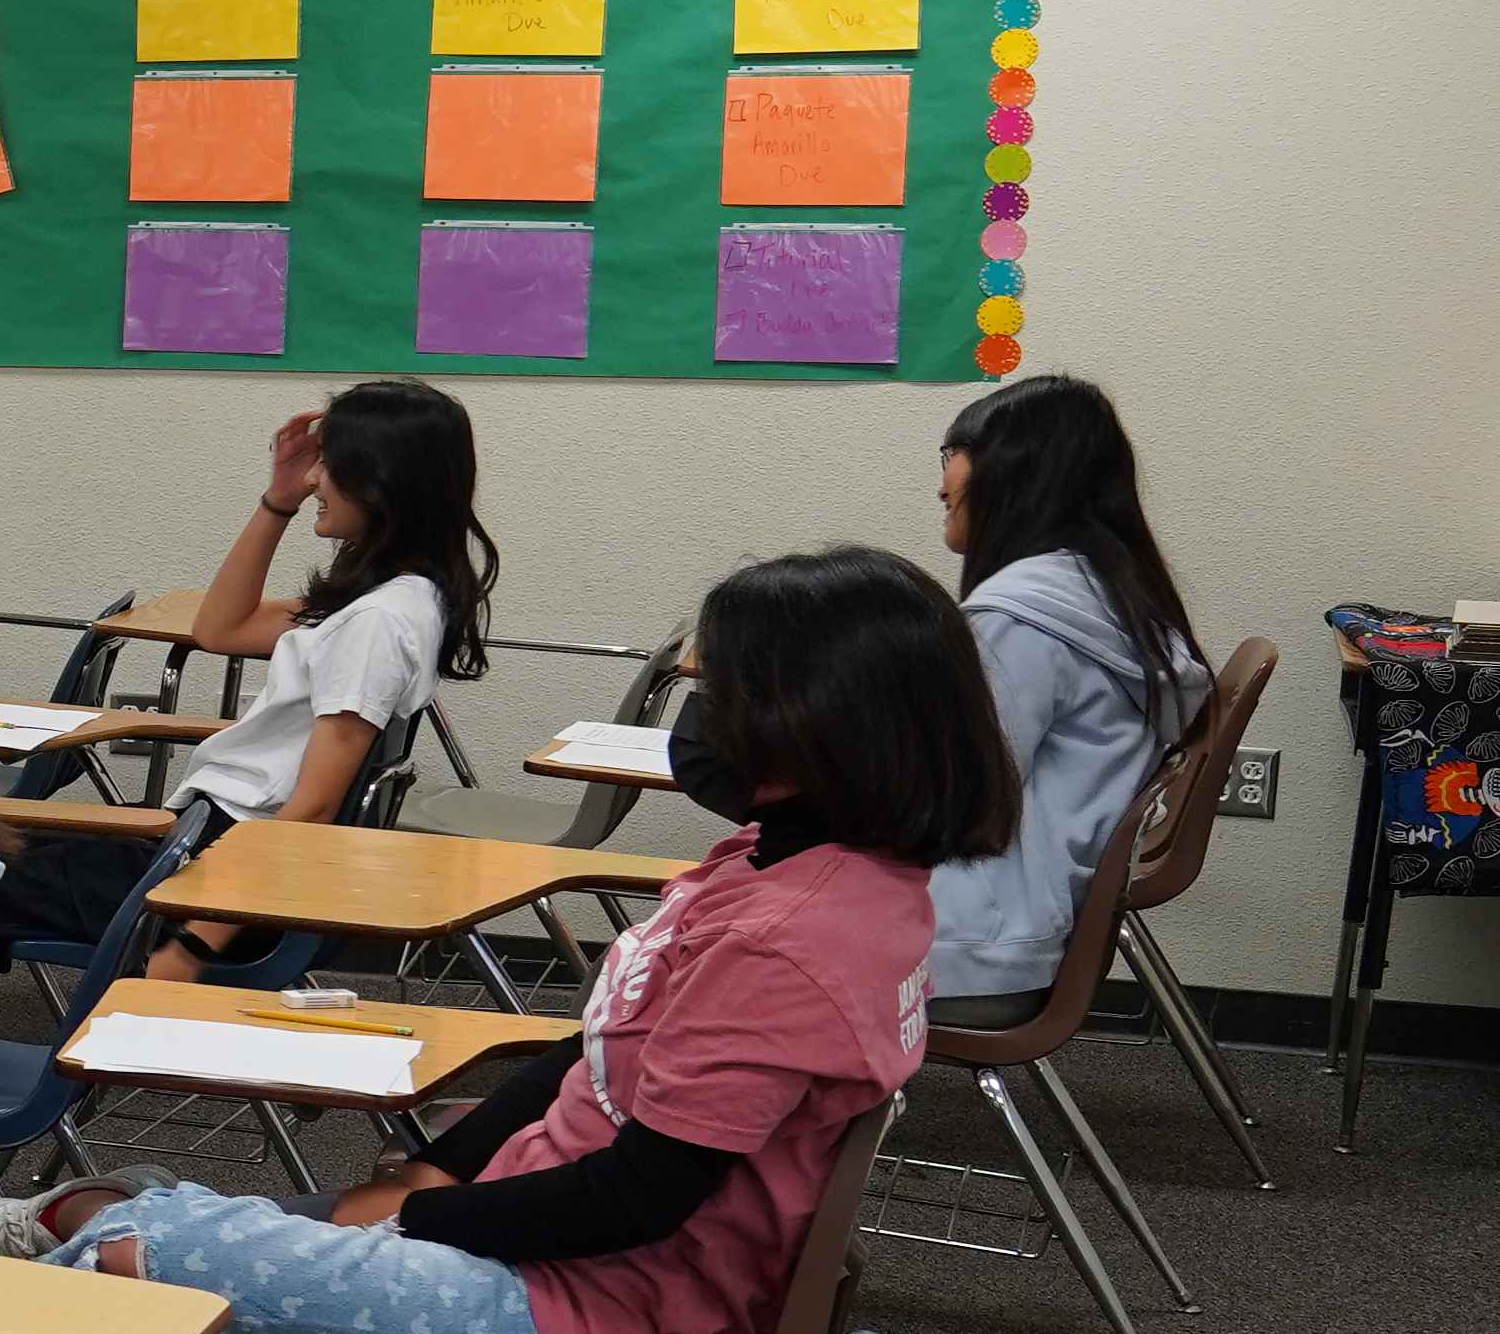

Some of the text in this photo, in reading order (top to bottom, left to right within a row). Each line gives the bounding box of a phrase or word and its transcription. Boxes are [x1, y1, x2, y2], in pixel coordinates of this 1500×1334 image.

[756, 93, 836, 126] Paquete
[753, 132, 831, 155] Amarillo
[780, 164, 826, 188] Due
